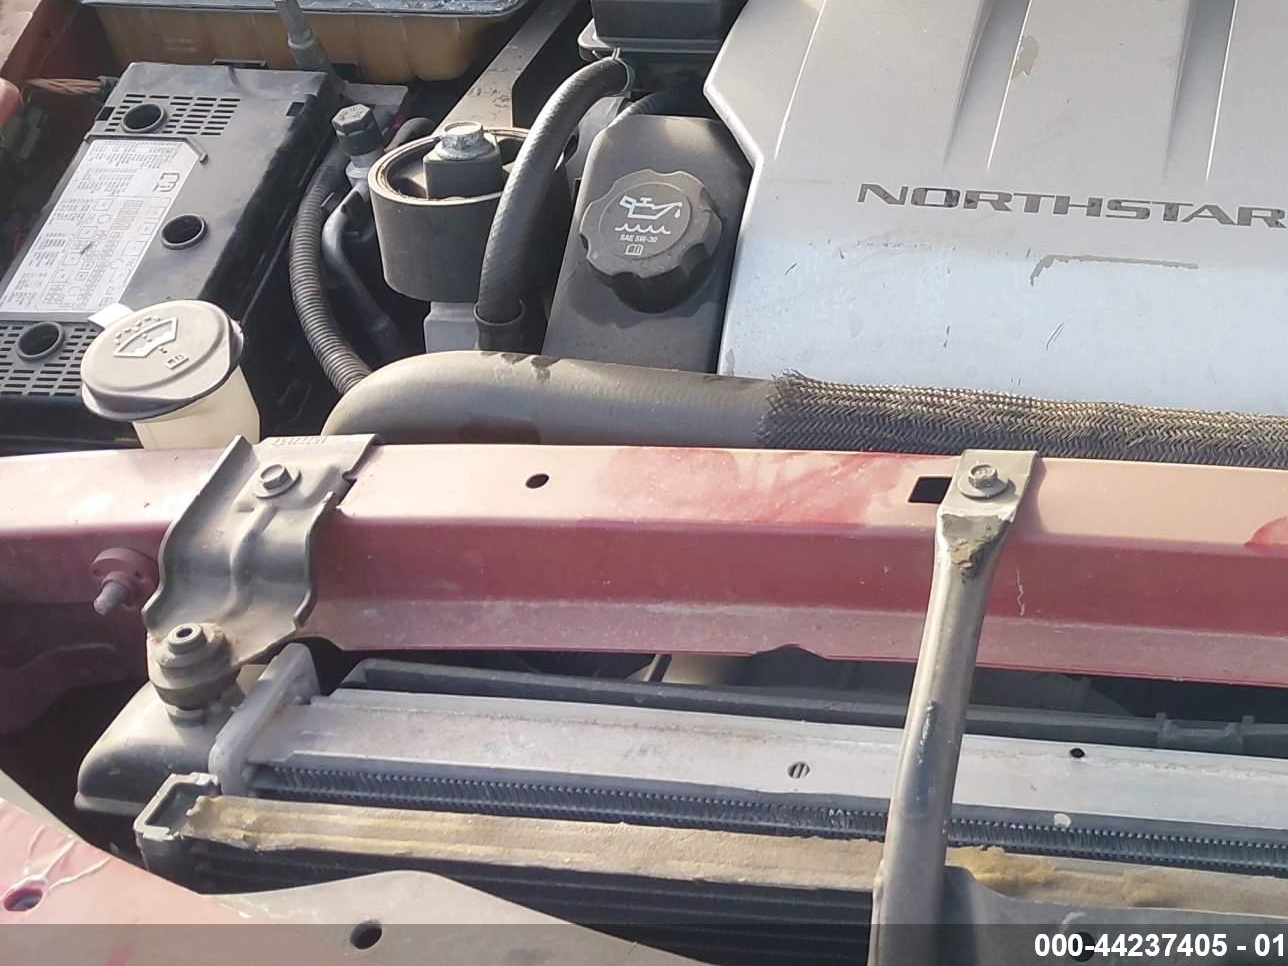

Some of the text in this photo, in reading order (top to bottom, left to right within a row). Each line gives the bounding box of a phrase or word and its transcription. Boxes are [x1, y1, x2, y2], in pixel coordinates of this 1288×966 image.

[858, 183, 1286, 229] NORTHSTAR
[619, 233, 658, 243] SAE 5W-30
